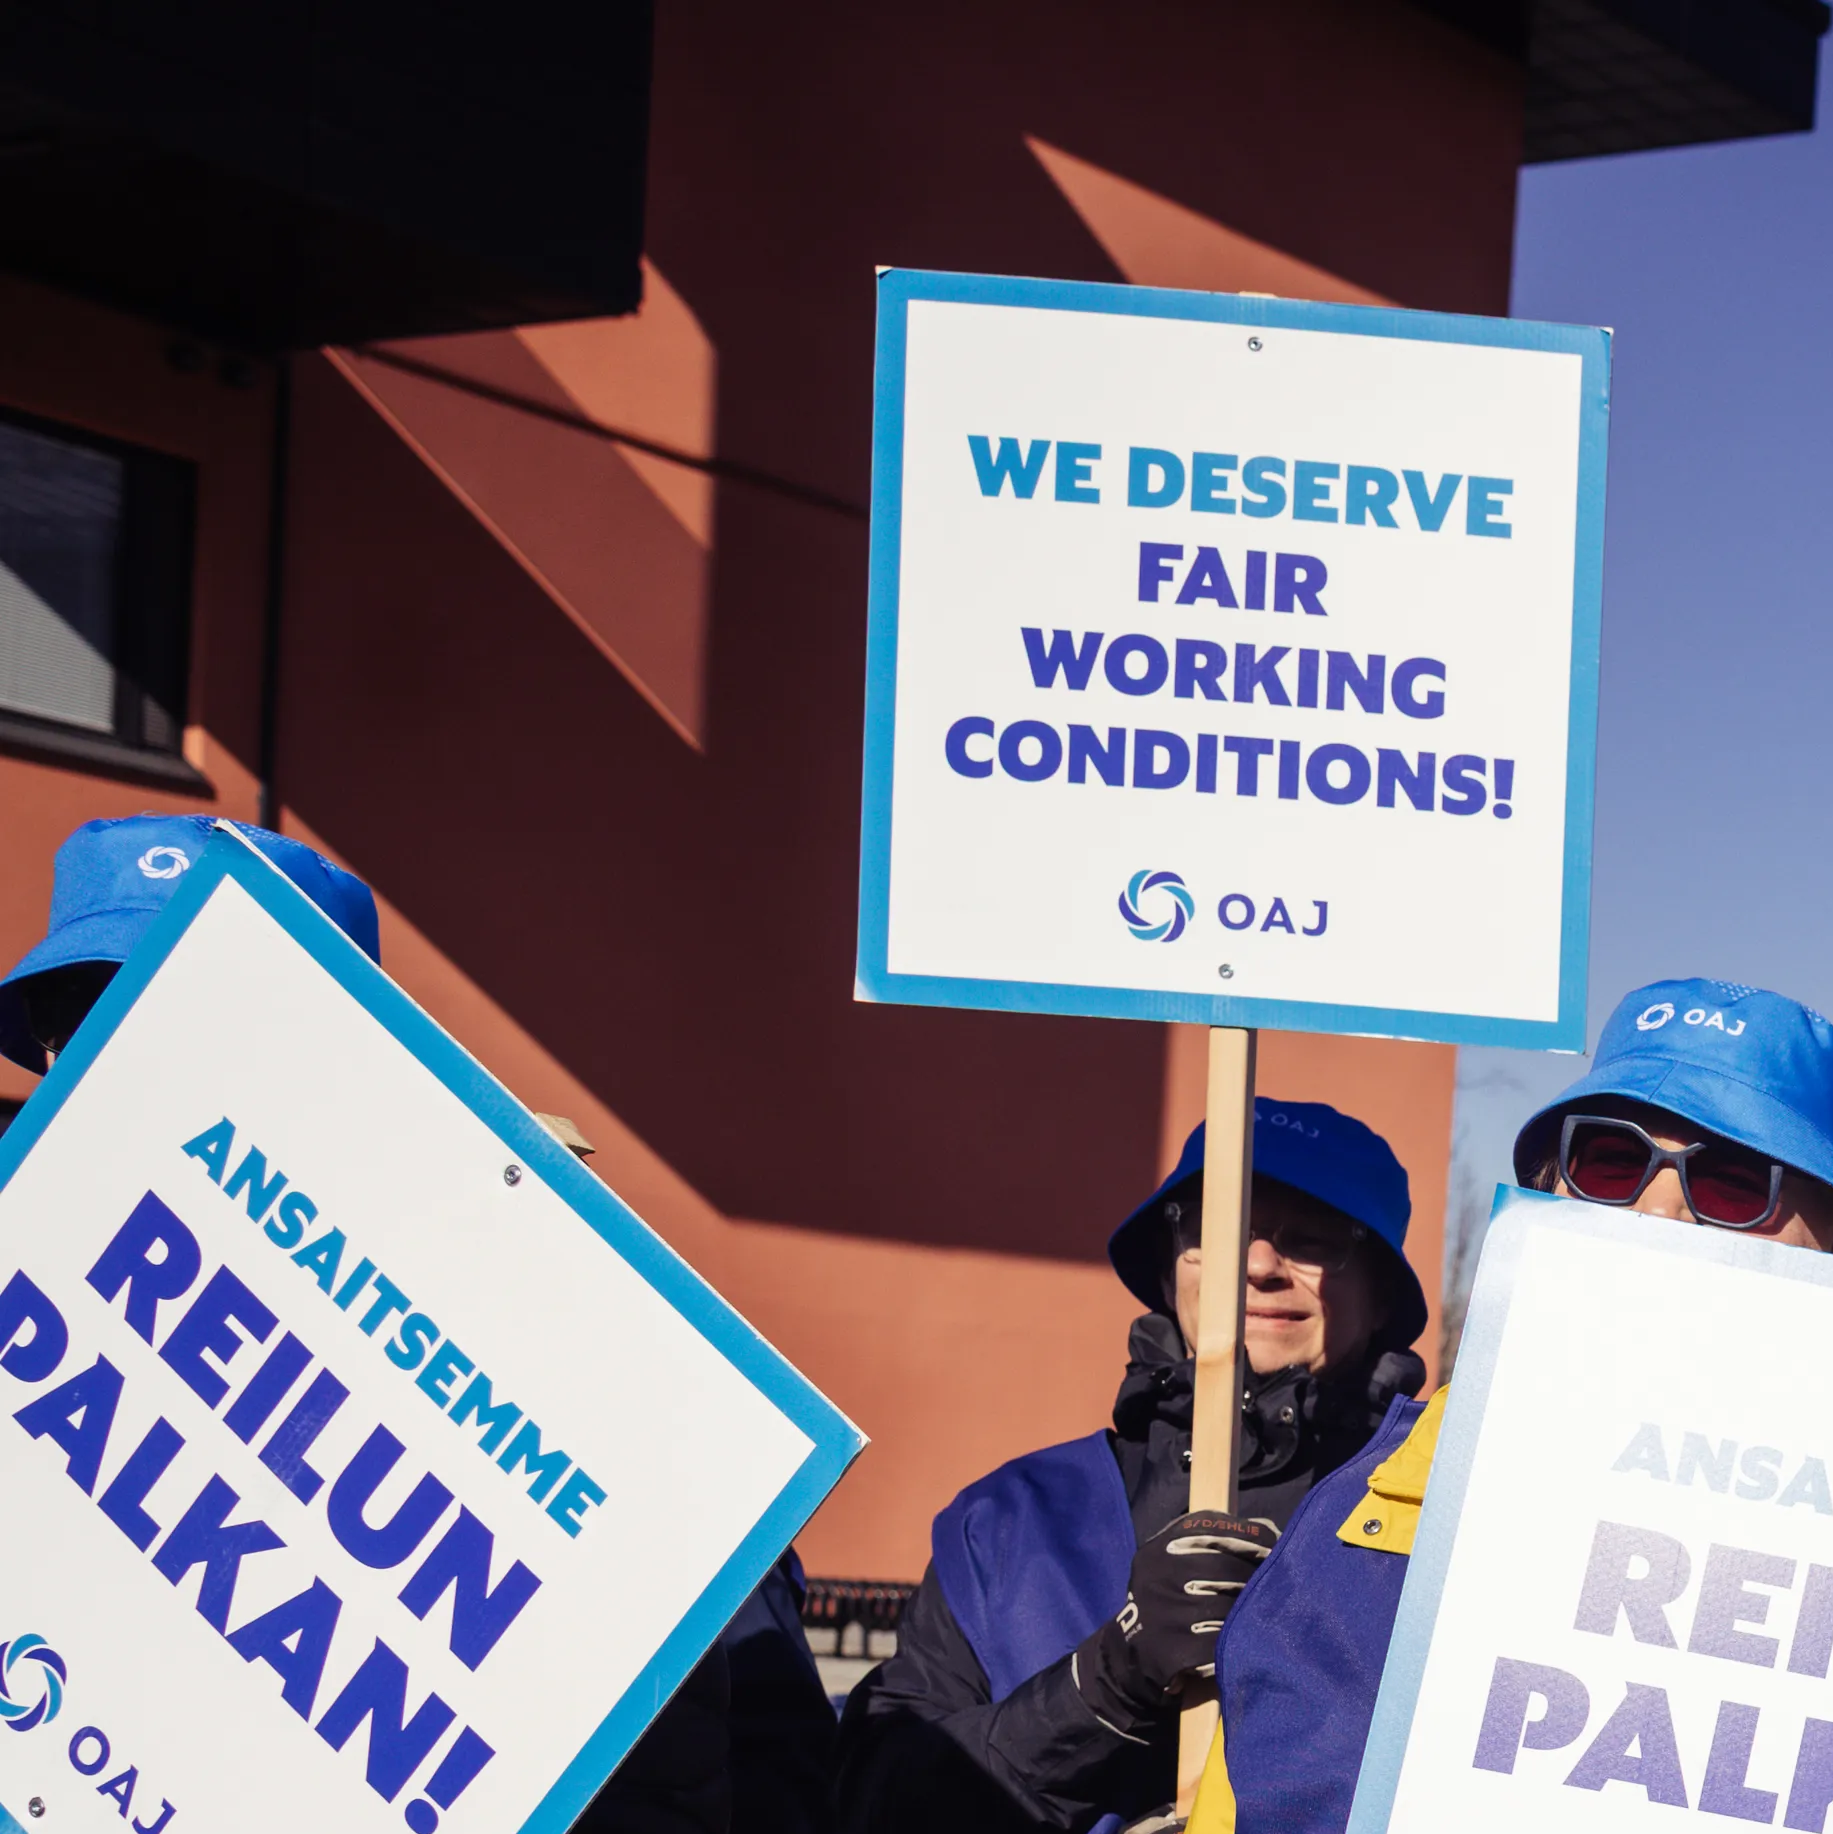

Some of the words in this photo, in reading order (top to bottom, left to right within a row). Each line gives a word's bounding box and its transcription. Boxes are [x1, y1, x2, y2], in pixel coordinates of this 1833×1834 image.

[967, 434, 1102, 505] WE
[1127, 446, 1514, 538] DESERVE
[1138, 542, 1327, 616] FAIR
[1021, 627, 1446, 720] WORKING
[945, 716, 1514, 819] CONDITIONS!
[1218, 893, 1327, 936] OAJ
[1683, 1008, 1746, 1036] OAJ
[1270, 1112, 1321, 1139] OAJ
[181, 1116, 608, 1538] ANSAITSEMME
[85, 1189, 542, 1672] REILUN
